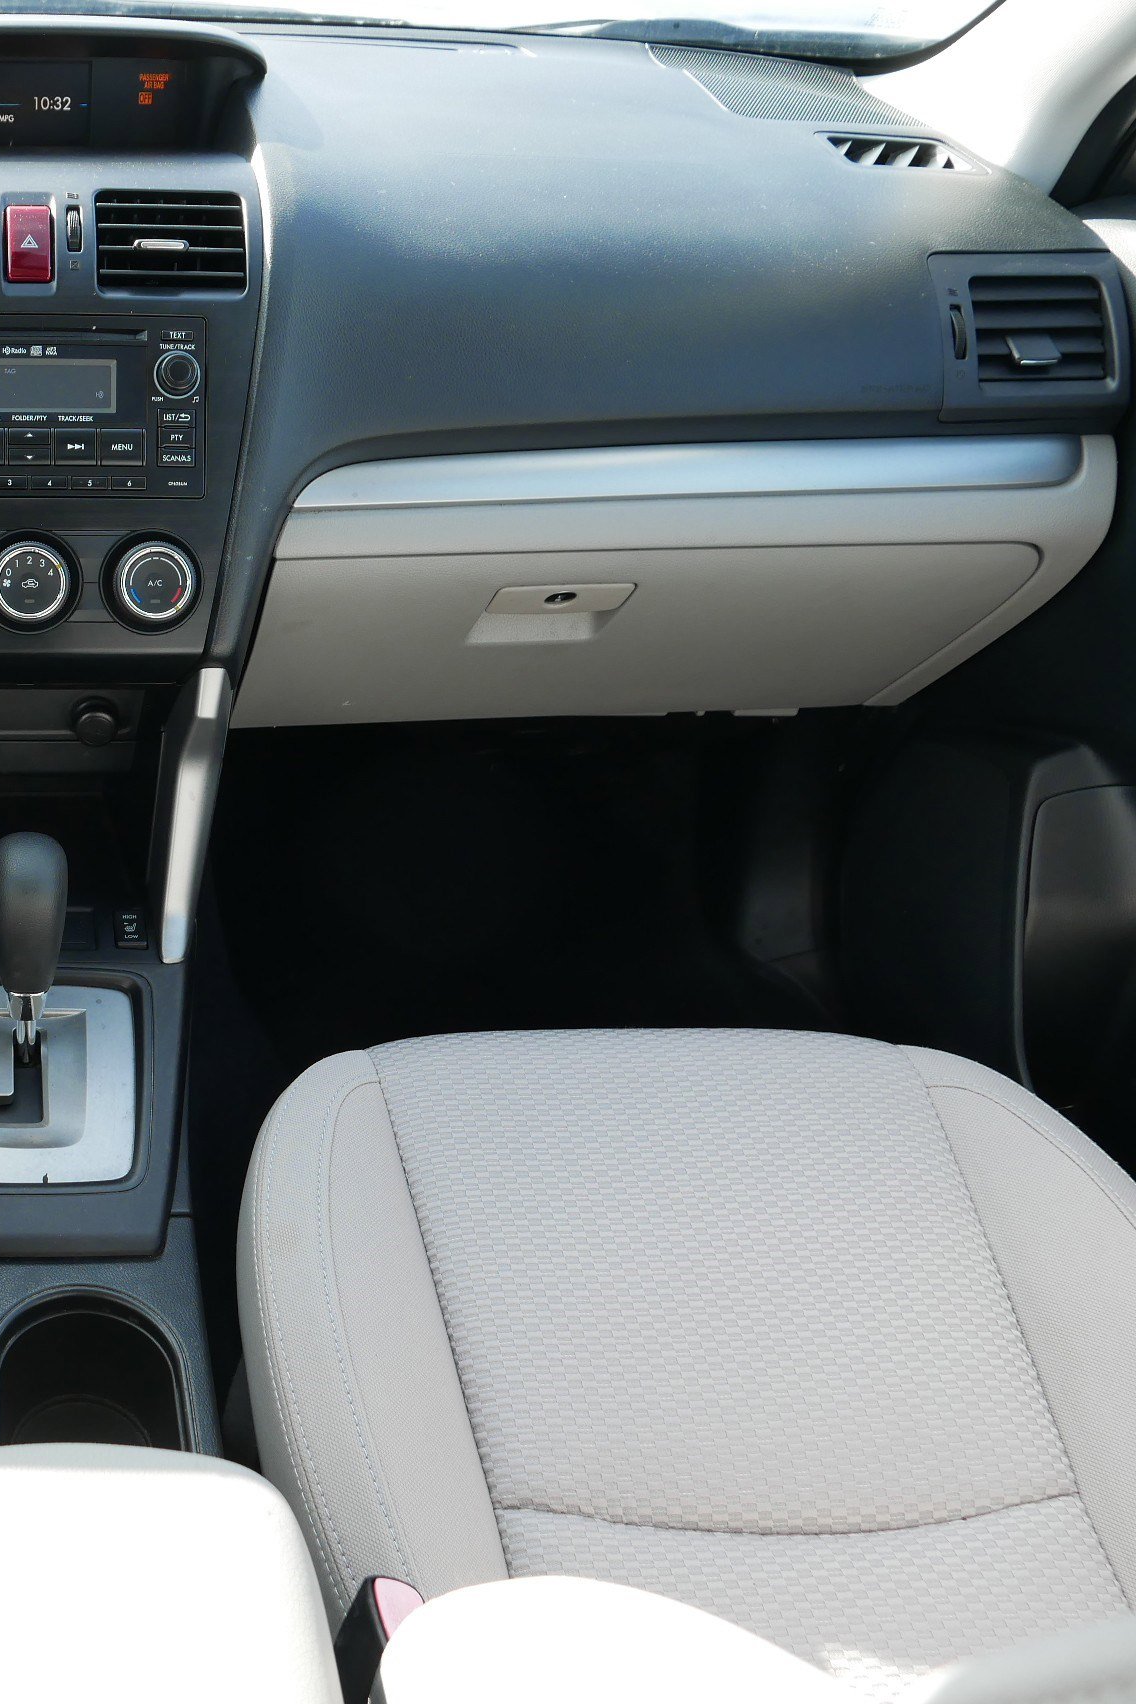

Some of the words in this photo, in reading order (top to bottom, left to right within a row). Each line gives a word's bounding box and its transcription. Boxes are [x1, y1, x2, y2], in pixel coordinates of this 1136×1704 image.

[139, 73, 169, 81] PASSENGER
[139, 92, 152, 104] OFF
[33, 96, 71, 110] 10:32
[170, 331, 186, 339] TEXT
[111, 443, 134, 451] MENU
[14, 559, 19, 567] 1
[26, 556, 33, 565] 2
[39, 559, 45, 567] 3
[5, 569, 12, 577] 0
[47, 568, 54, 576] 4
[147, 579, 163, 587] A/C
